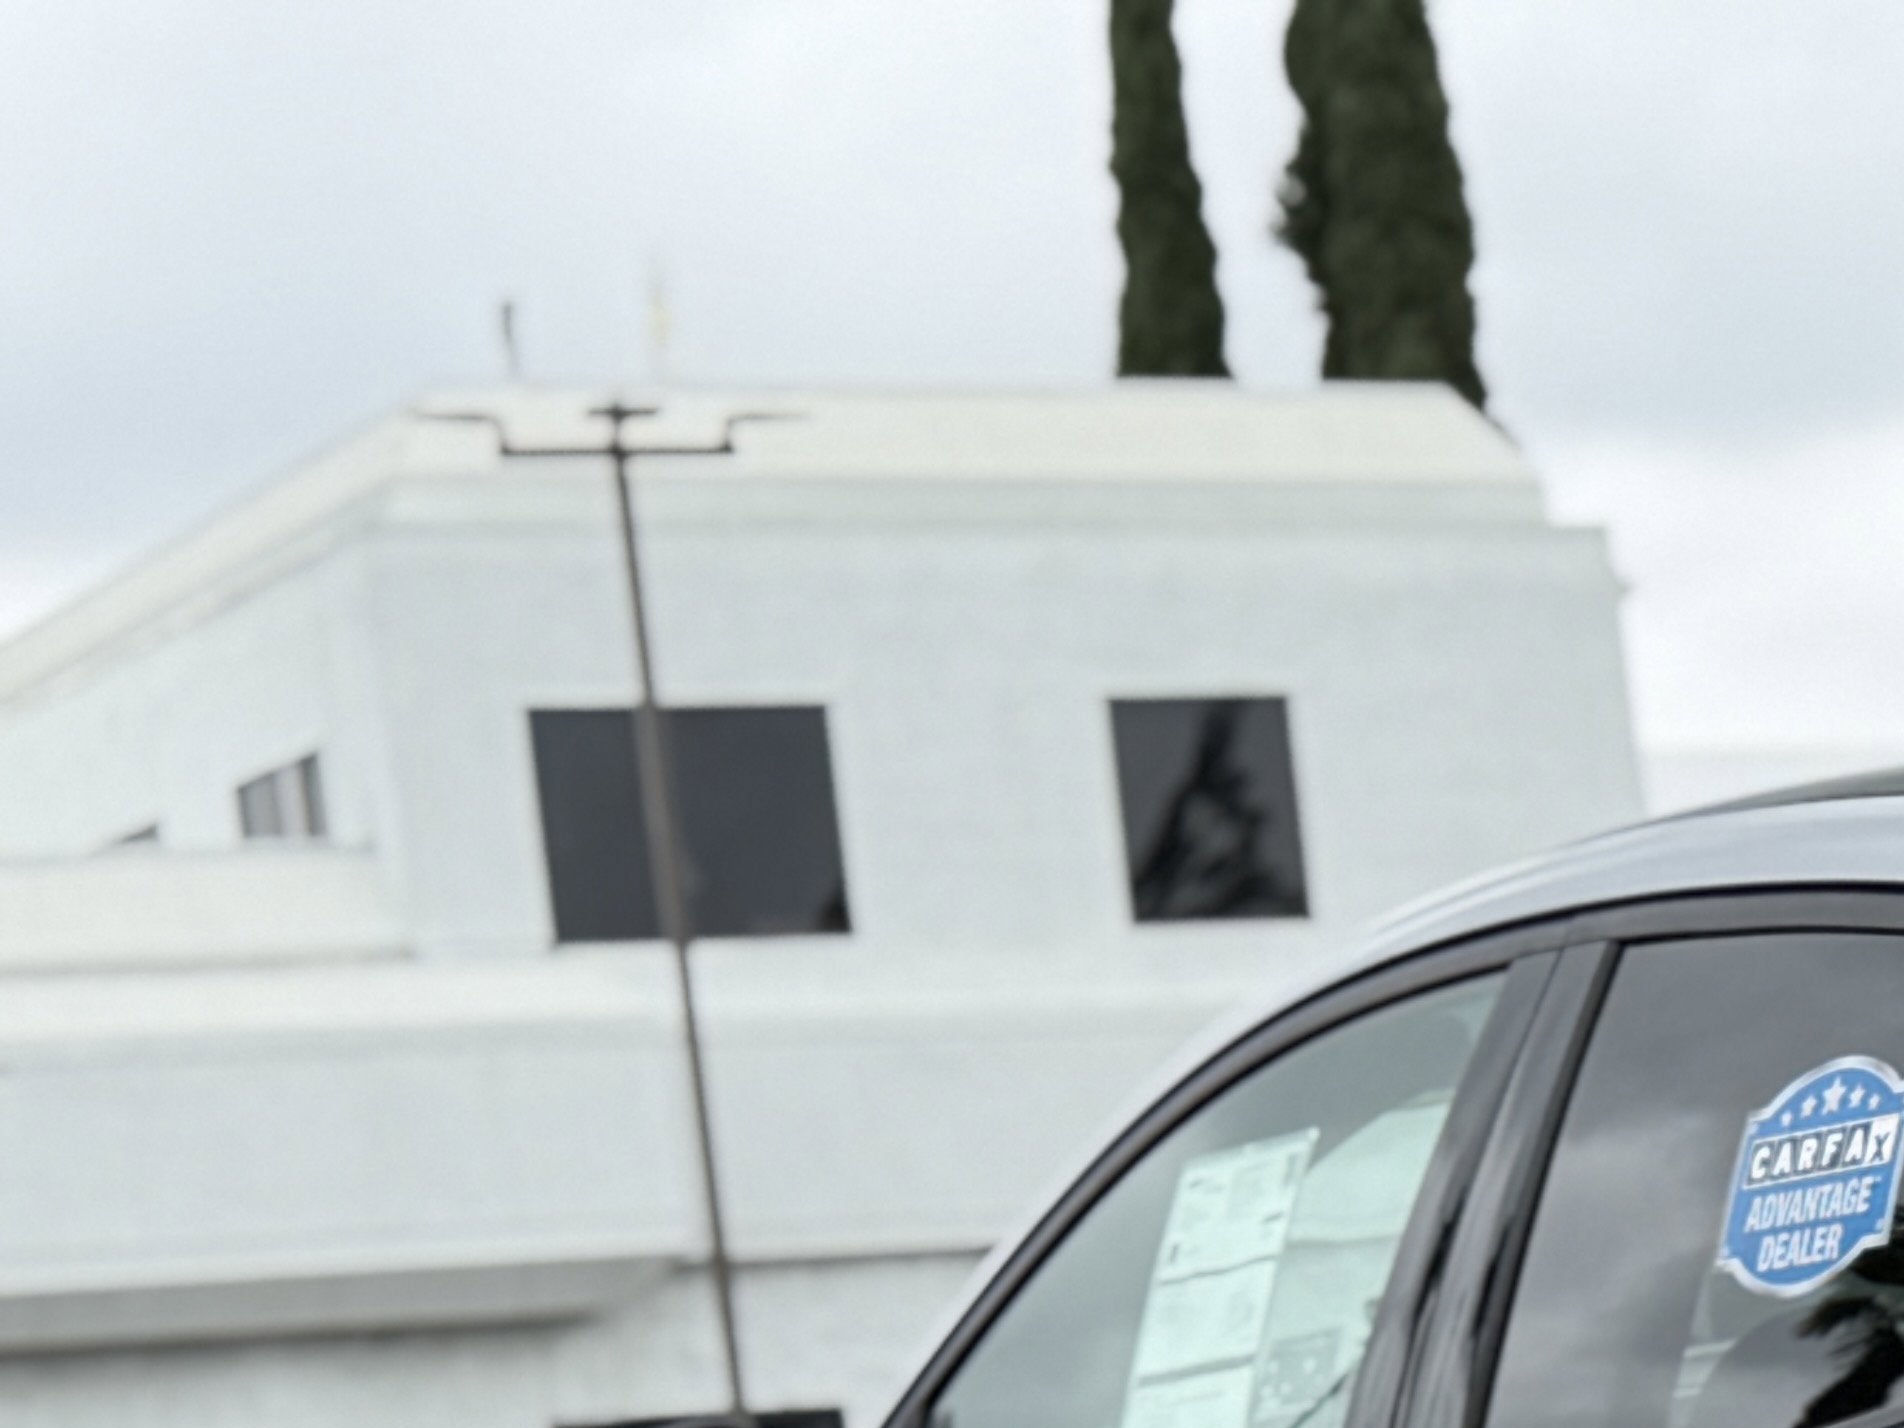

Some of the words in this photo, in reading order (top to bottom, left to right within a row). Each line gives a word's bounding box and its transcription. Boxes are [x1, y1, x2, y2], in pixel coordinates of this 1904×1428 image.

[1750, 1126, 1894, 1181] CARFAX
[1744, 1176, 1874, 1233] ADVANTAGE
[1756, 1224, 1843, 1273] DEALER
